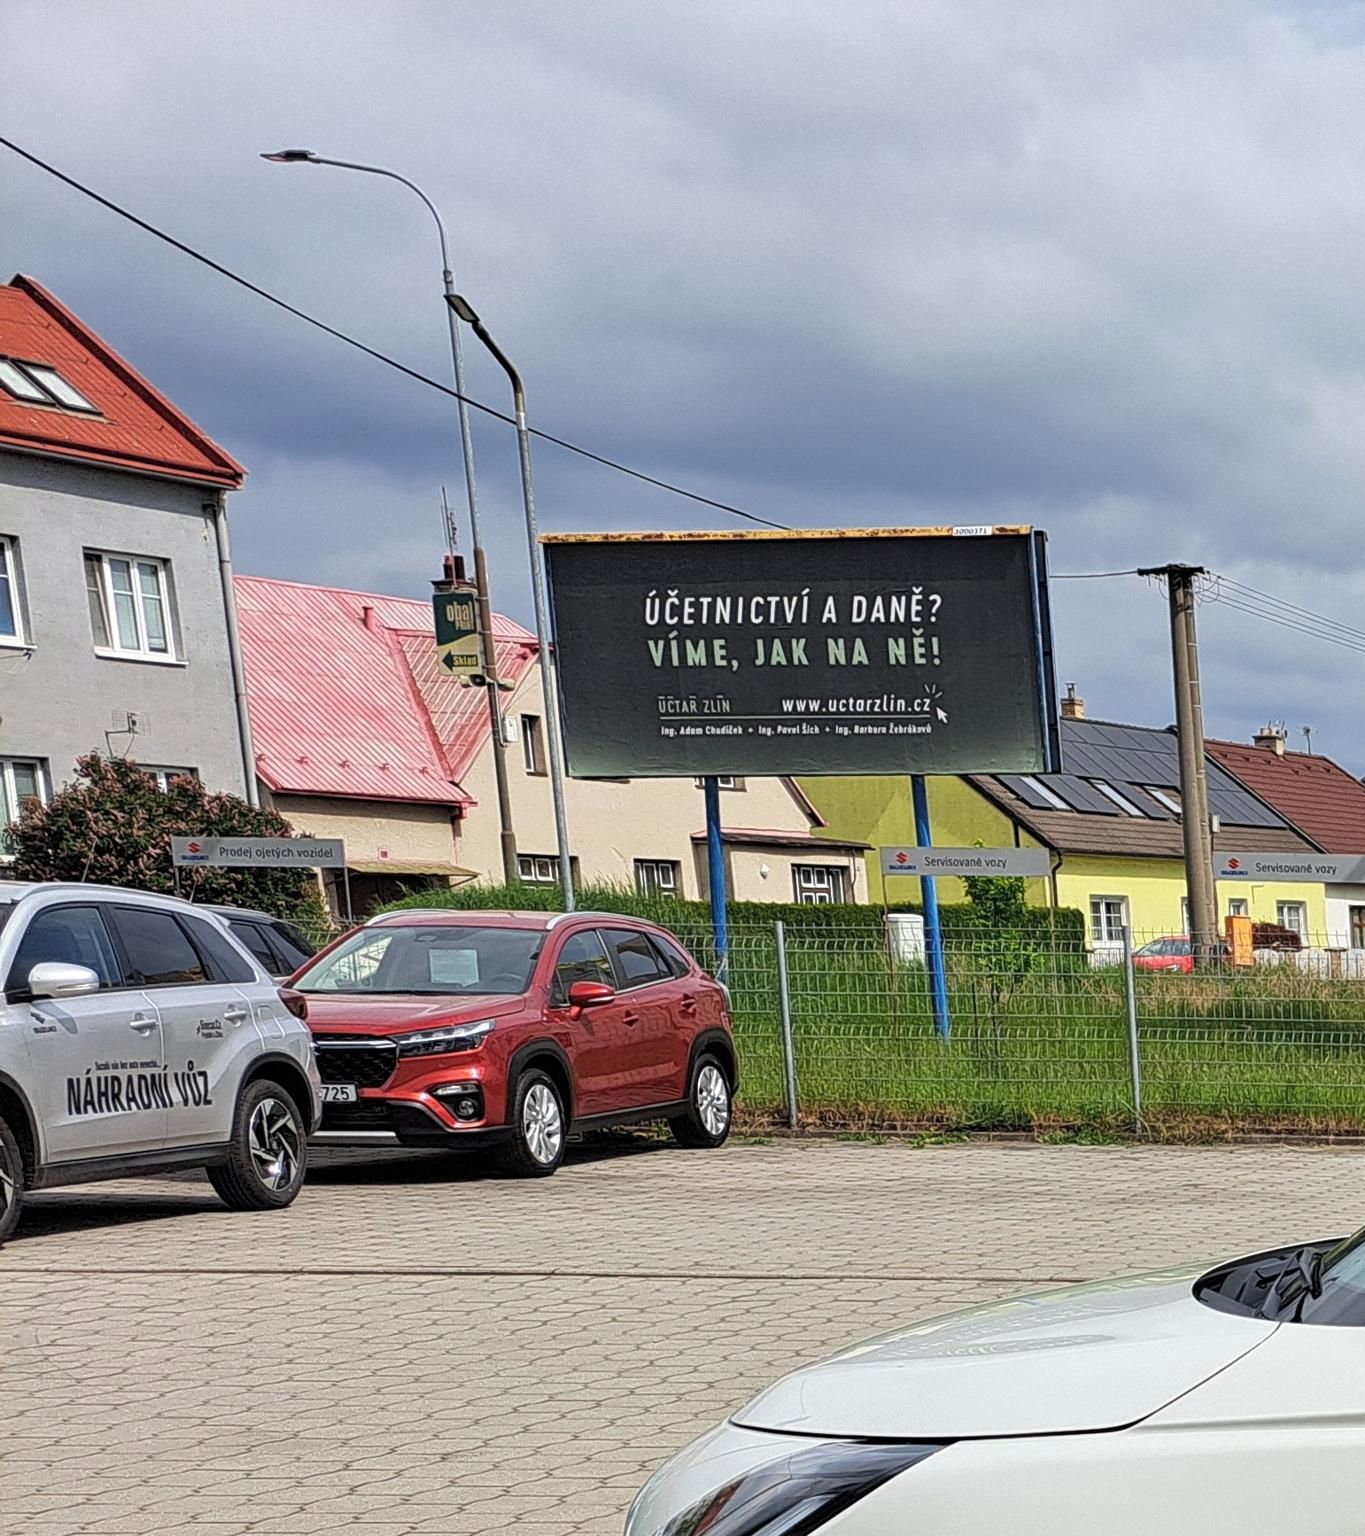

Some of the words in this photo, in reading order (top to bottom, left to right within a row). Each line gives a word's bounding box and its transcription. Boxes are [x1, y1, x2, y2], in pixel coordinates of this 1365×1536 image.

[645, 588, 811, 625] ÚČETNICTVÍ
[821, 595, 837, 624] A
[851, 586, 942, 623] DANĚ?
[647, 630, 740, 672] VÍME,
[755, 638, 809, 666] JAK
[827, 637, 869, 666] NA
[887, 627, 941, 666] NĚ!
[782, 694, 931, 712] www.uctarzlin.cz
[661, 726, 677, 737] Ing.
[680, 725, 703, 735] Adam
[758, 725, 774, 736] Ing.
[777, 724, 800, 735] Pavel
[835, 725, 851, 736] Ing.
[219, 846, 252, 859] Prodej
[255, 846, 294, 859] ojetých
[297, 847, 334, 859] vozidel
[924, 856, 982, 868] Servisované
[985, 859, 1007, 869] vozy
[1255, 862, 1312, 874] Servisované
[1315, 865, 1337, 876] vozy
[66, 1064, 174, 1116] NÁHRADNÍ
[174, 1060, 213, 1108] VŮZ
